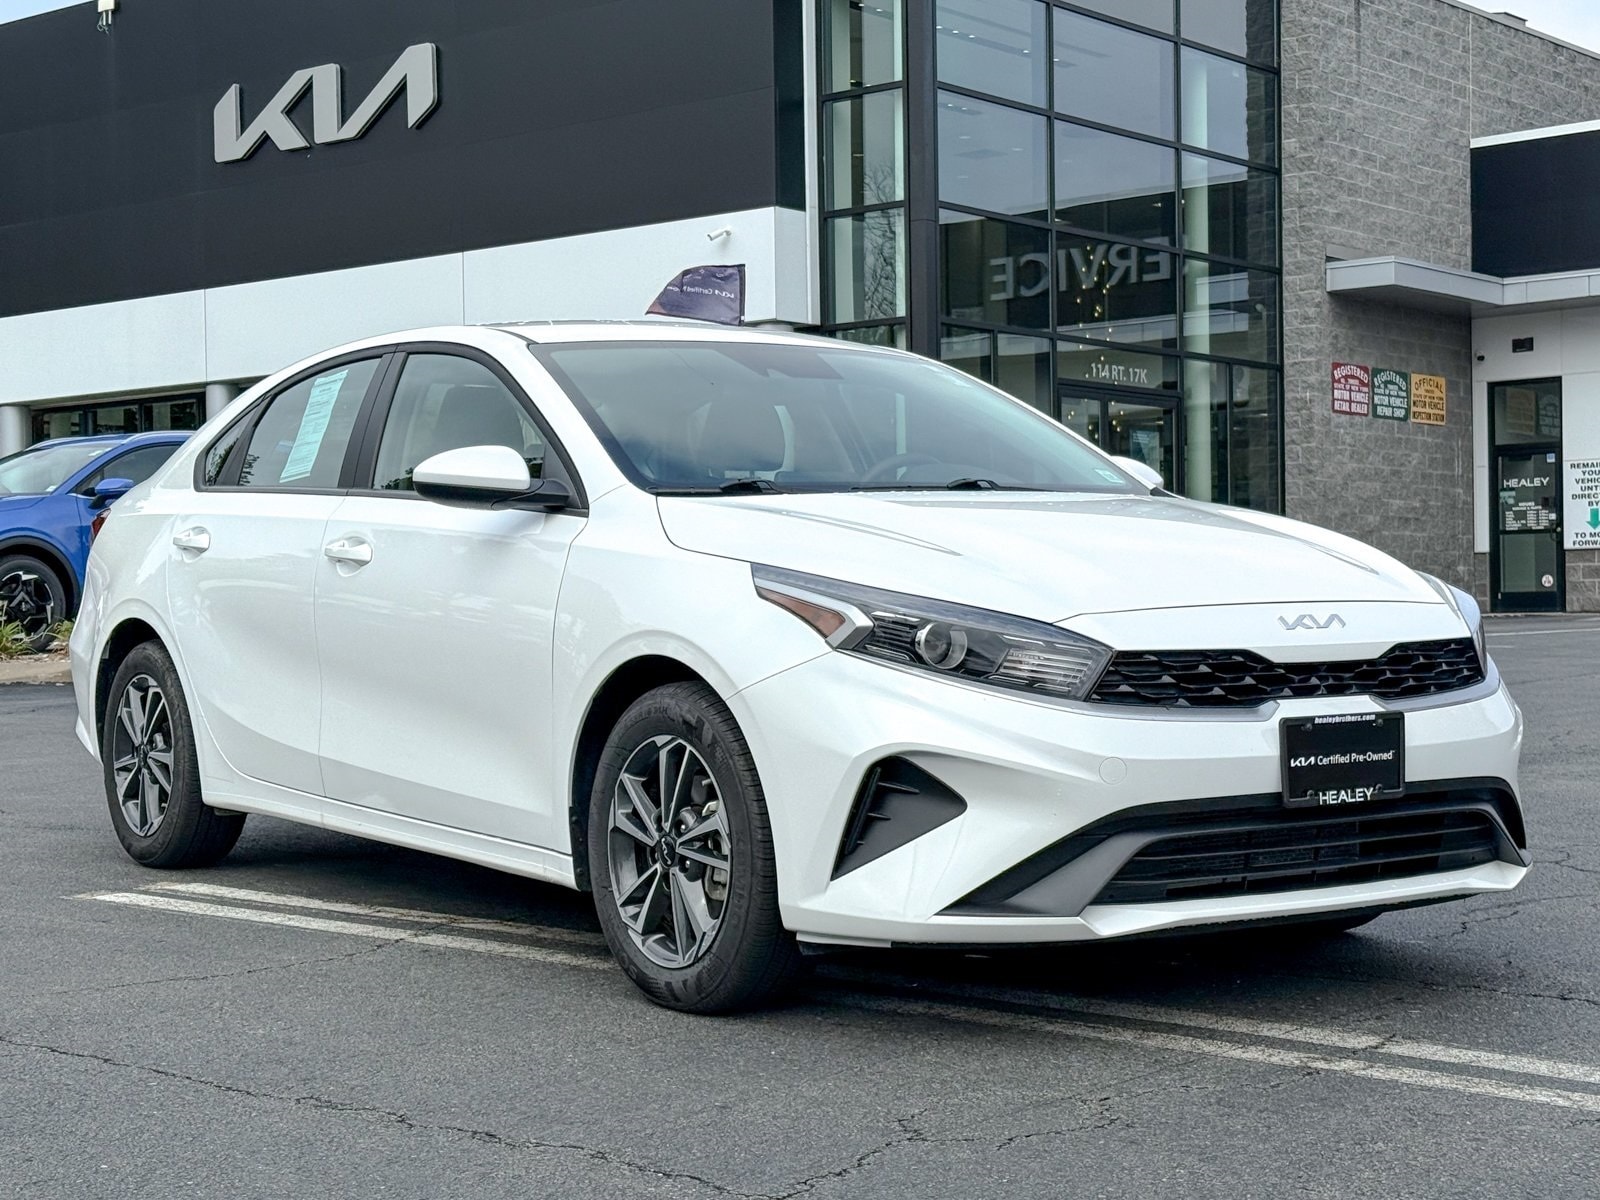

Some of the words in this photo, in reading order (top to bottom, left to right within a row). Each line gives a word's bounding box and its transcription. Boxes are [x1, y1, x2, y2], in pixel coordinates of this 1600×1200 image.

[213, 42, 438, 164] KIA
[1090, 362, 1110, 378] 114
[1111, 365, 1127, 381] RT.
[1129, 367, 1148, 384] 17K
[1334, 365, 1368, 383] REGISTERED
[1374, 371, 1406, 389] REGISTERED
[1415, 378, 1443, 393] OFFICIAL
[1334, 390, 1349, 399] MOTOR
[1351, 392, 1368, 403] VEHICLE
[1374, 395, 1388, 405] MOTOR
[1390, 397, 1407, 407] VEHICLE
[1335, 400, 1349, 411] RETAIL
[1351, 403, 1367, 413] DEALER
[1377, 406, 1392, 416] REPAIR
[1394, 408, 1405, 417] SHOP
[1413, 400, 1426, 408] MOTOR
[1428, 402, 1443, 410] VEHICLE
[1413, 411, 1431, 420] INSPECTION
[1432, 413, 1444, 421] STATION
[1504, 477, 1549, 488] HEALEY
[1277, 613, 1346, 631] KIA
[1314, 714, 1376, 724] healeybrothers.com
[1290, 755, 1315, 767] KIA
[1317, 754, 1350, 766] Certified
[1319, 787, 1374, 805] HEALEY
